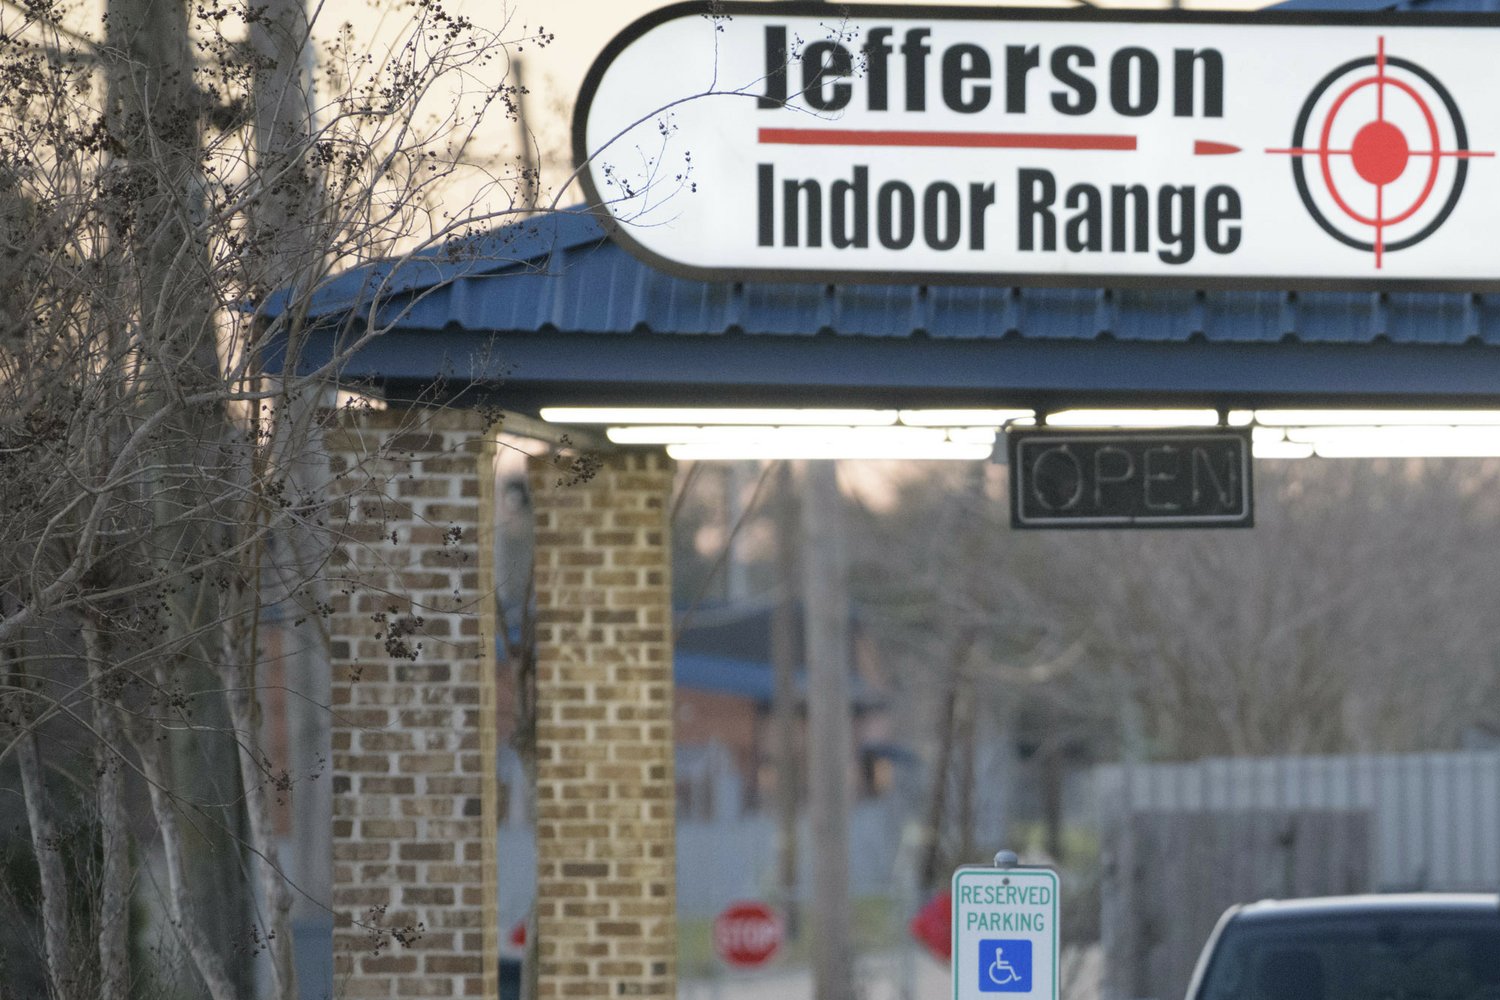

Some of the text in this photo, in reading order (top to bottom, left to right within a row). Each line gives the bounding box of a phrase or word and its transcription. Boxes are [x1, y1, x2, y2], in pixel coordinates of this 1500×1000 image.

[757, 24, 1224, 118] Jefferson
[757, 163, 1242, 265] Indoor Range
[1032, 446, 1236, 509] OPEN
[961, 885, 1050, 905] RESERVED
[719, 922, 776, 948] STOP
[967, 912, 1044, 931] PARKING
